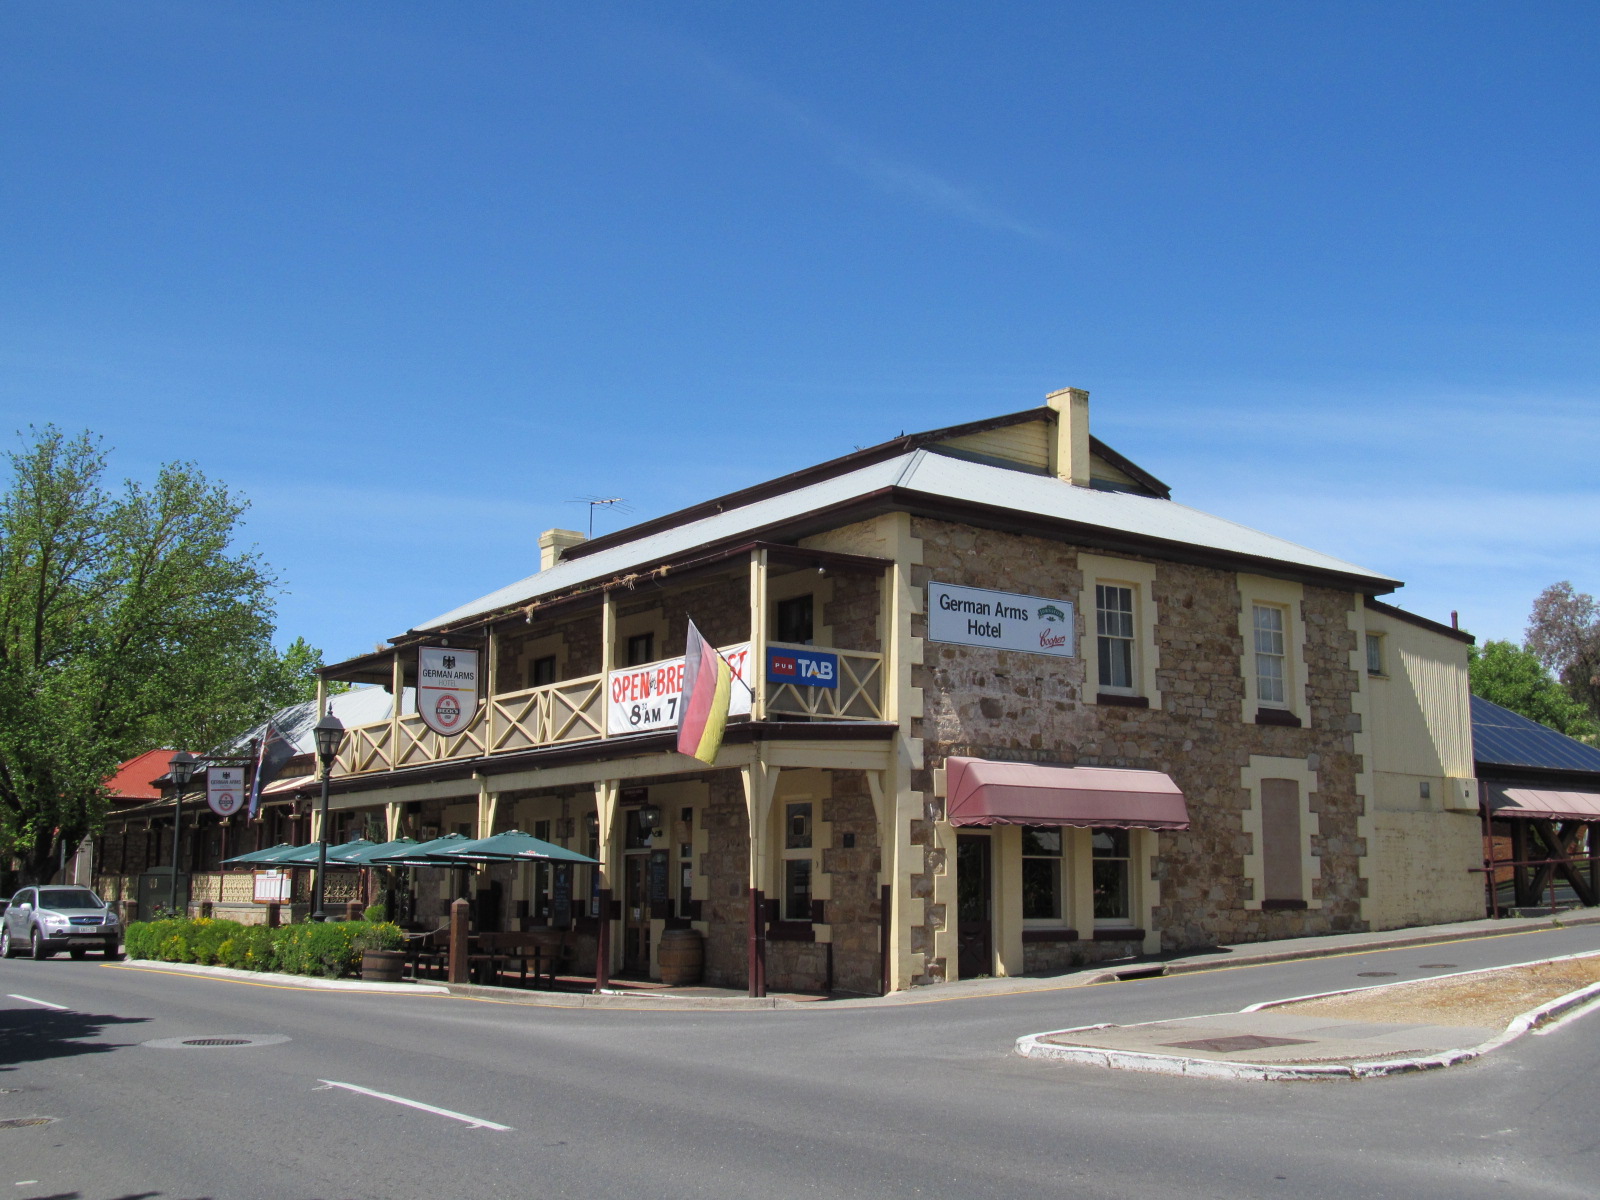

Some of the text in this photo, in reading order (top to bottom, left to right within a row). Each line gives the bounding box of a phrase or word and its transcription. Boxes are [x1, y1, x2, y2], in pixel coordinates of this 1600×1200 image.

[940, 594, 1029, 621] German Arms
[968, 619, 1001, 638] Hotel
[423, 669, 474, 680] GERMAN ARMS
[798, 659, 833, 679] TAB
[612, 672, 650, 703] OPEN
[667, 697, 678, 720] 7
